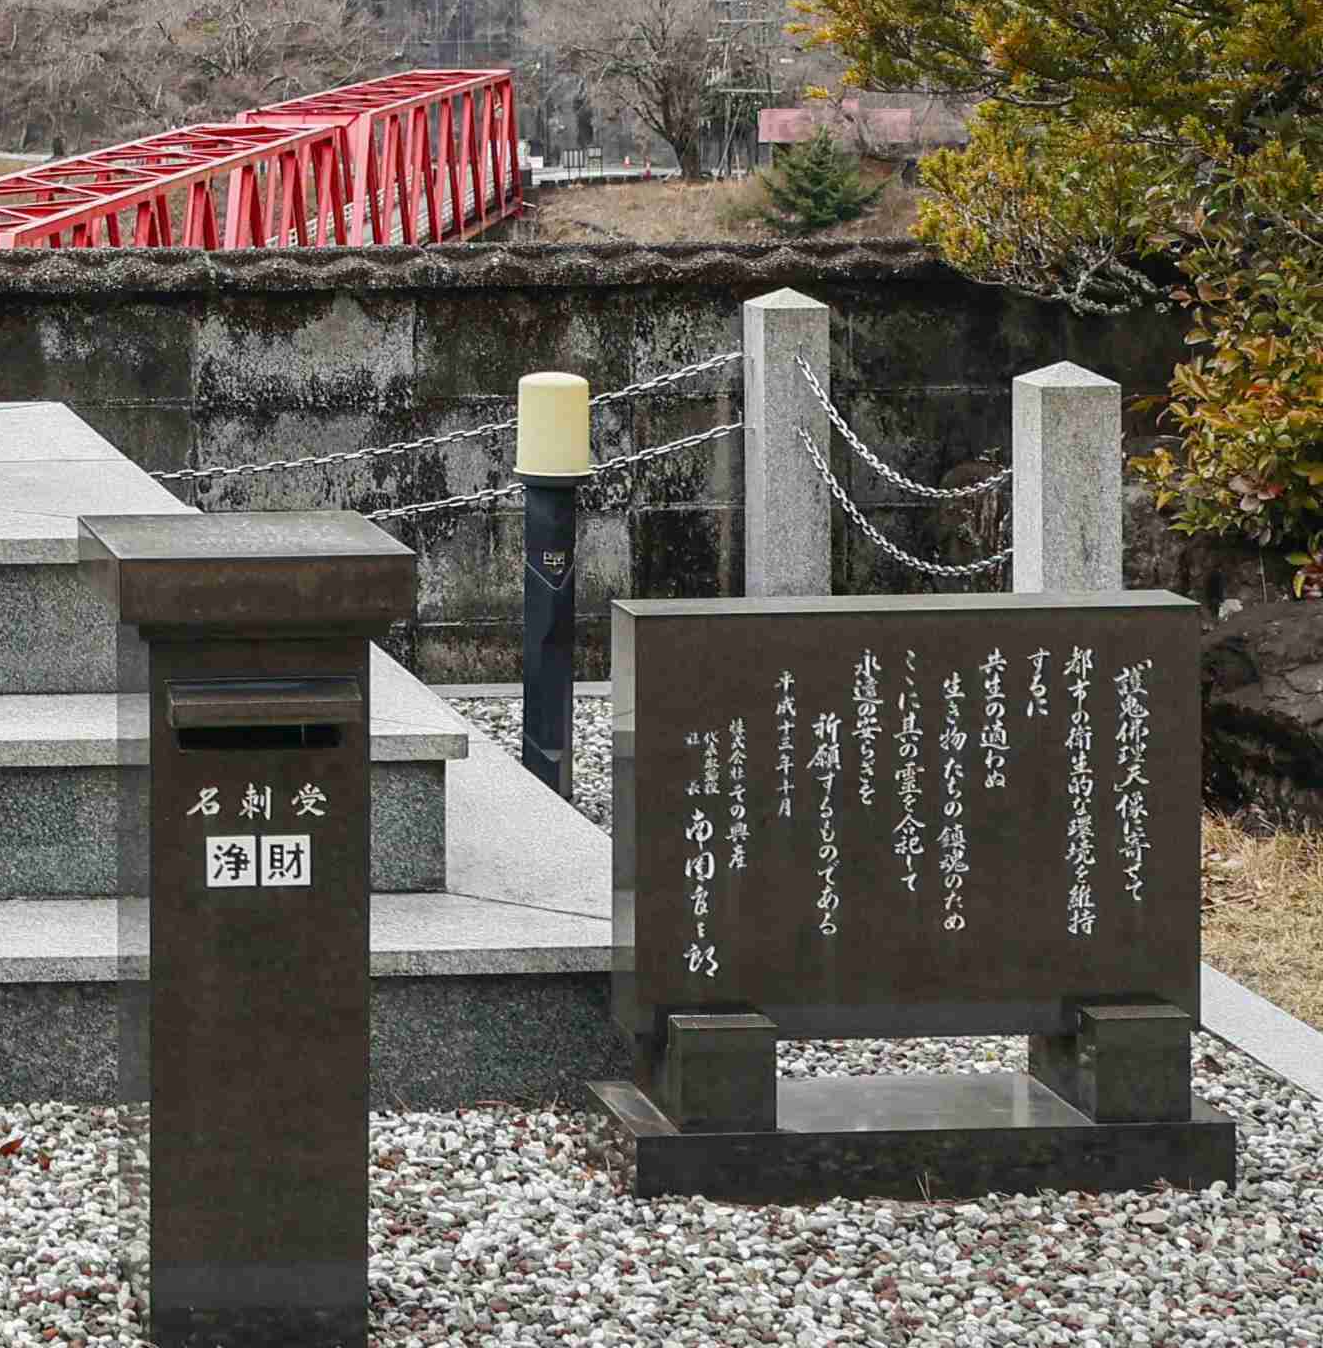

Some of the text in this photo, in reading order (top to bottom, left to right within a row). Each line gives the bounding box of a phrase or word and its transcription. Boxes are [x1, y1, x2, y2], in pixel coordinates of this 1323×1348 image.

[851, 648, 884, 806] 永遠の安らぎを
[1026, 647, 1051, 717] するに
[774, 670, 797, 818] 平成十三年十月
[186, 782, 327, 821] 名刺受
[806, 711, 843, 936] 祈願するものである
[212, 841, 305, 881] 浄財
